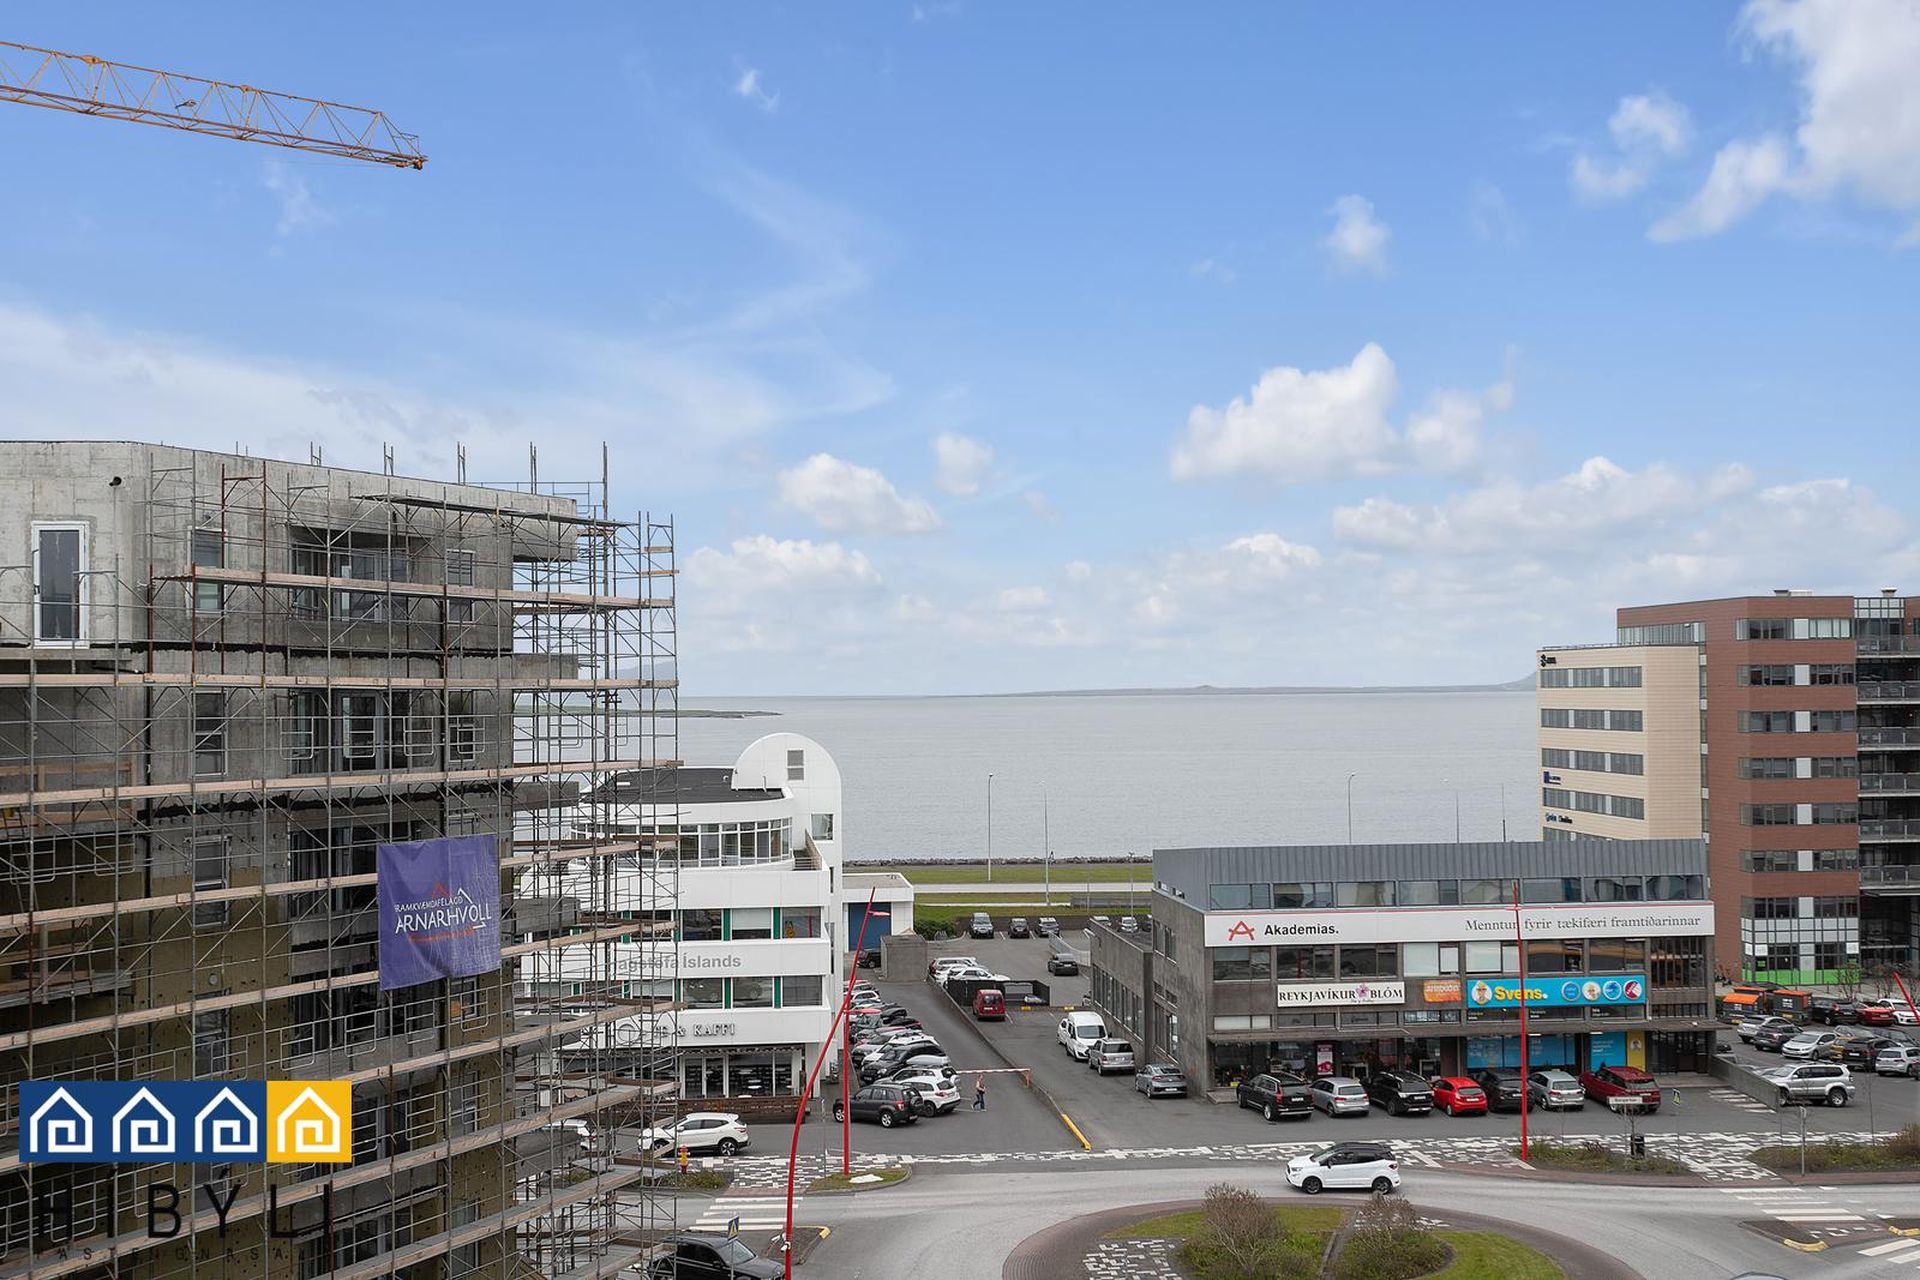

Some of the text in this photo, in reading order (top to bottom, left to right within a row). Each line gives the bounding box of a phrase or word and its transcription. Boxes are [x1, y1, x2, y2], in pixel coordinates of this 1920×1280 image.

[394, 903, 492, 934] ARNARHVOLL
[1524, 918, 1552, 932] fyrir
[1557, 916, 1608, 929] tækifæri
[1264, 923, 1339, 936] Akademias.
[618, 954, 677, 973] agstofa
[1279, 986, 1403, 1002] REYKJAVÍKUR BLÓM
[693, 1023, 737, 1037] KAFFI
